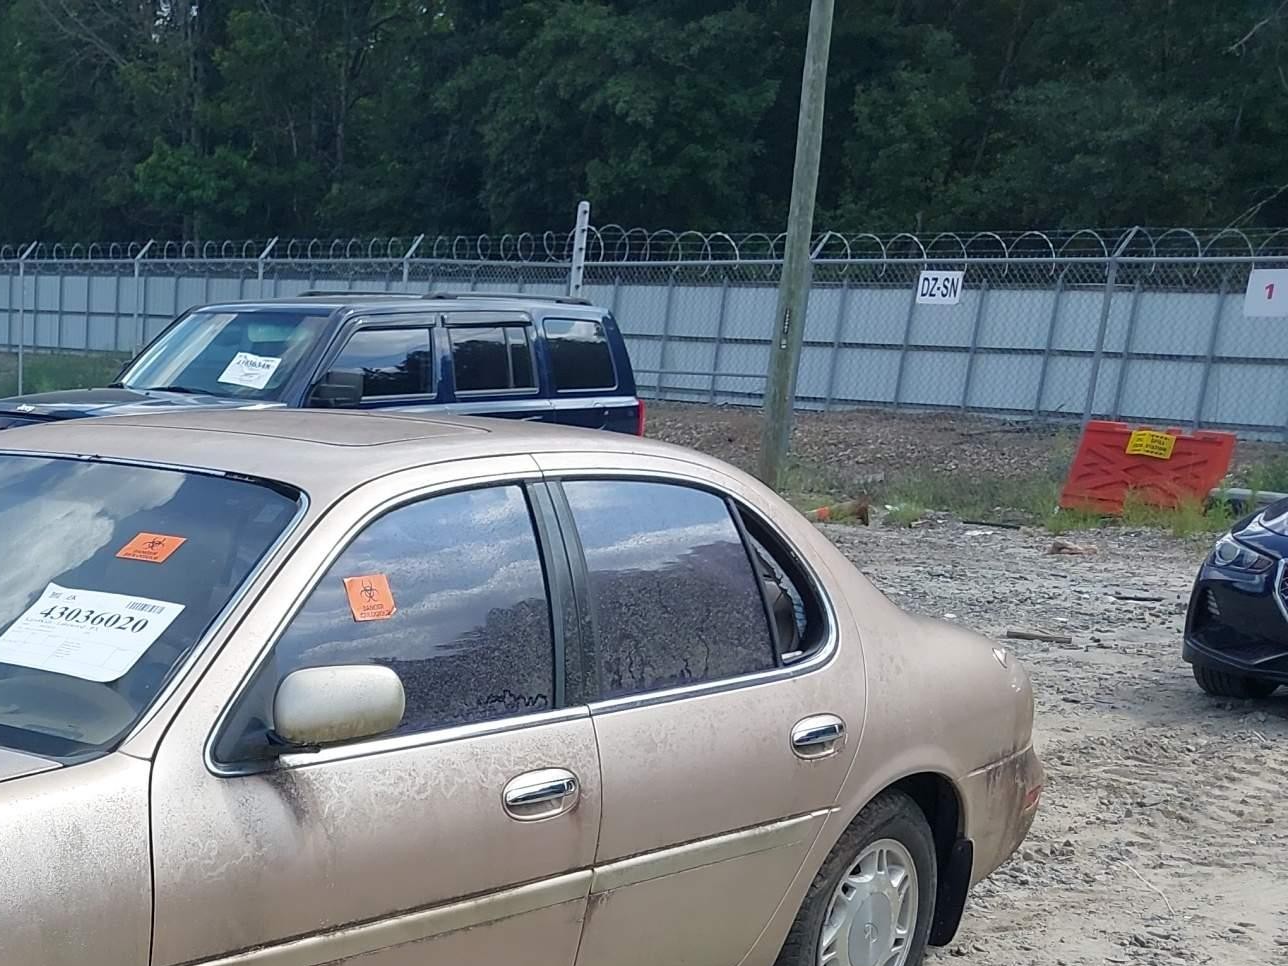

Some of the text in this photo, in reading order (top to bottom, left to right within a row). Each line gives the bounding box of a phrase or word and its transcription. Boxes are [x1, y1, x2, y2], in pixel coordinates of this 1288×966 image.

[920, 276, 960, 298] DZ-SN
[1264, 283, 1275, 300] 1
[40, 604, 149, 633] 43036020
